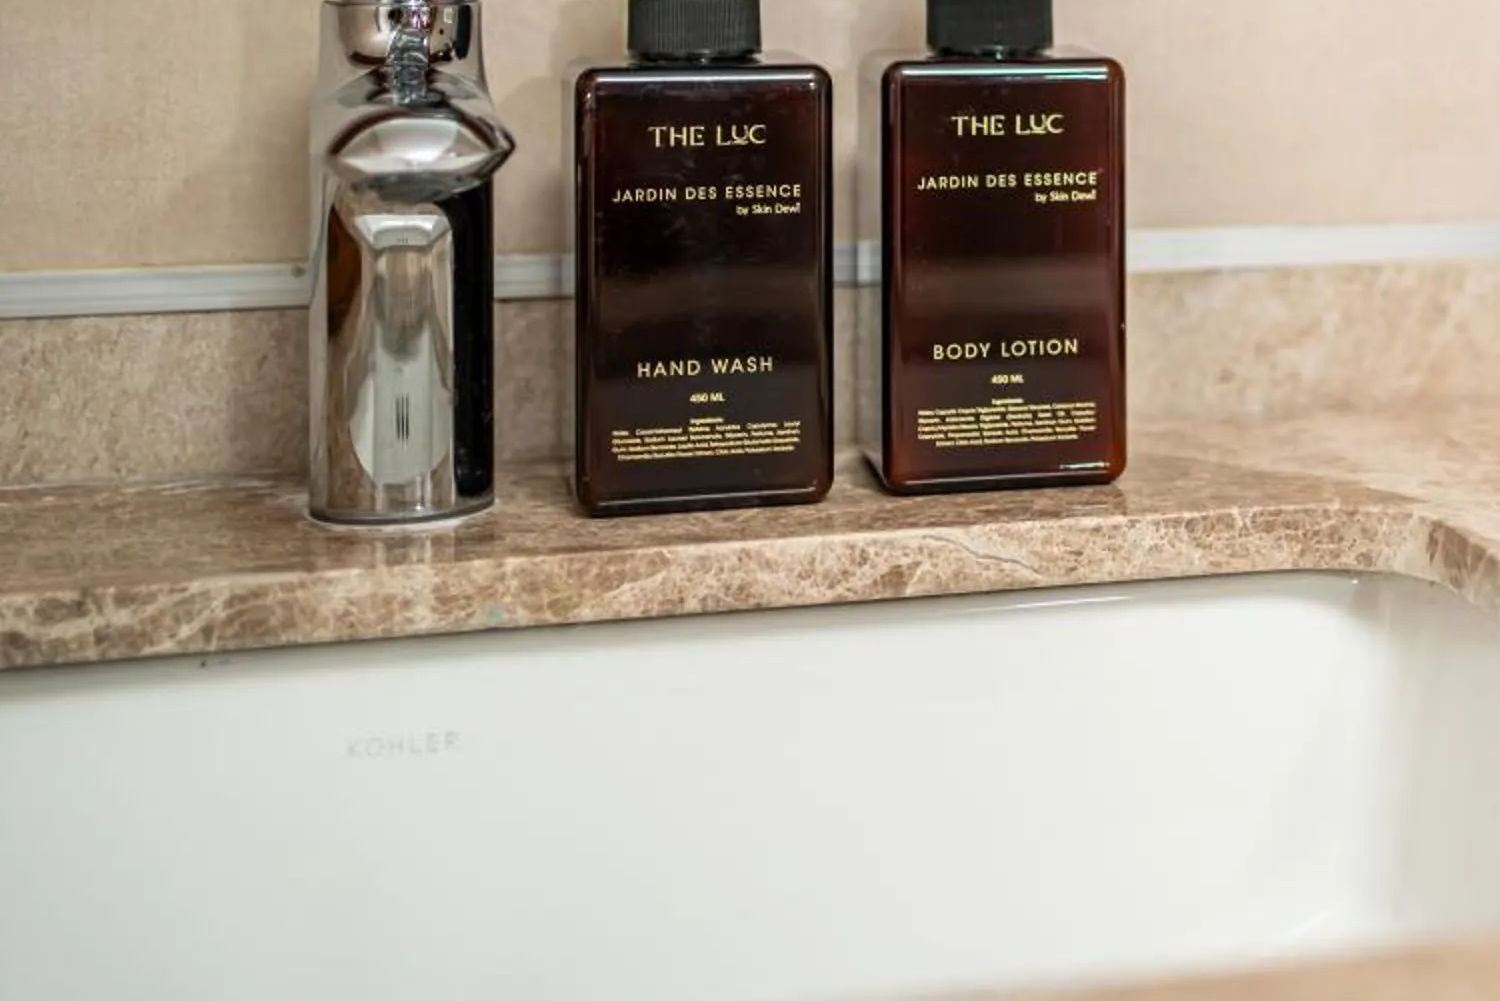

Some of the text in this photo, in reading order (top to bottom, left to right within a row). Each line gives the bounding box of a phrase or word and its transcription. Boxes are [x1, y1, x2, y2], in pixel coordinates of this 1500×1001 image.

[951, 113, 1064, 136] THE LUC
[648, 124, 767, 147] THE LUC
[917, 171, 1097, 190] JARDIN DES ESSENCE
[612, 183, 801, 203] JARDIN DES ESSENCE
[1034, 192, 1048, 203] by
[1050, 190, 1069, 202] Skin
[736, 205, 749, 215] by
[752, 203, 773, 214] Skin
[933, 338, 1079, 360] BODY LOTION
[636, 356, 774, 378] HAND WASH
[710, 392, 725, 402] ML
[345, 730, 461, 759] KOHLER
